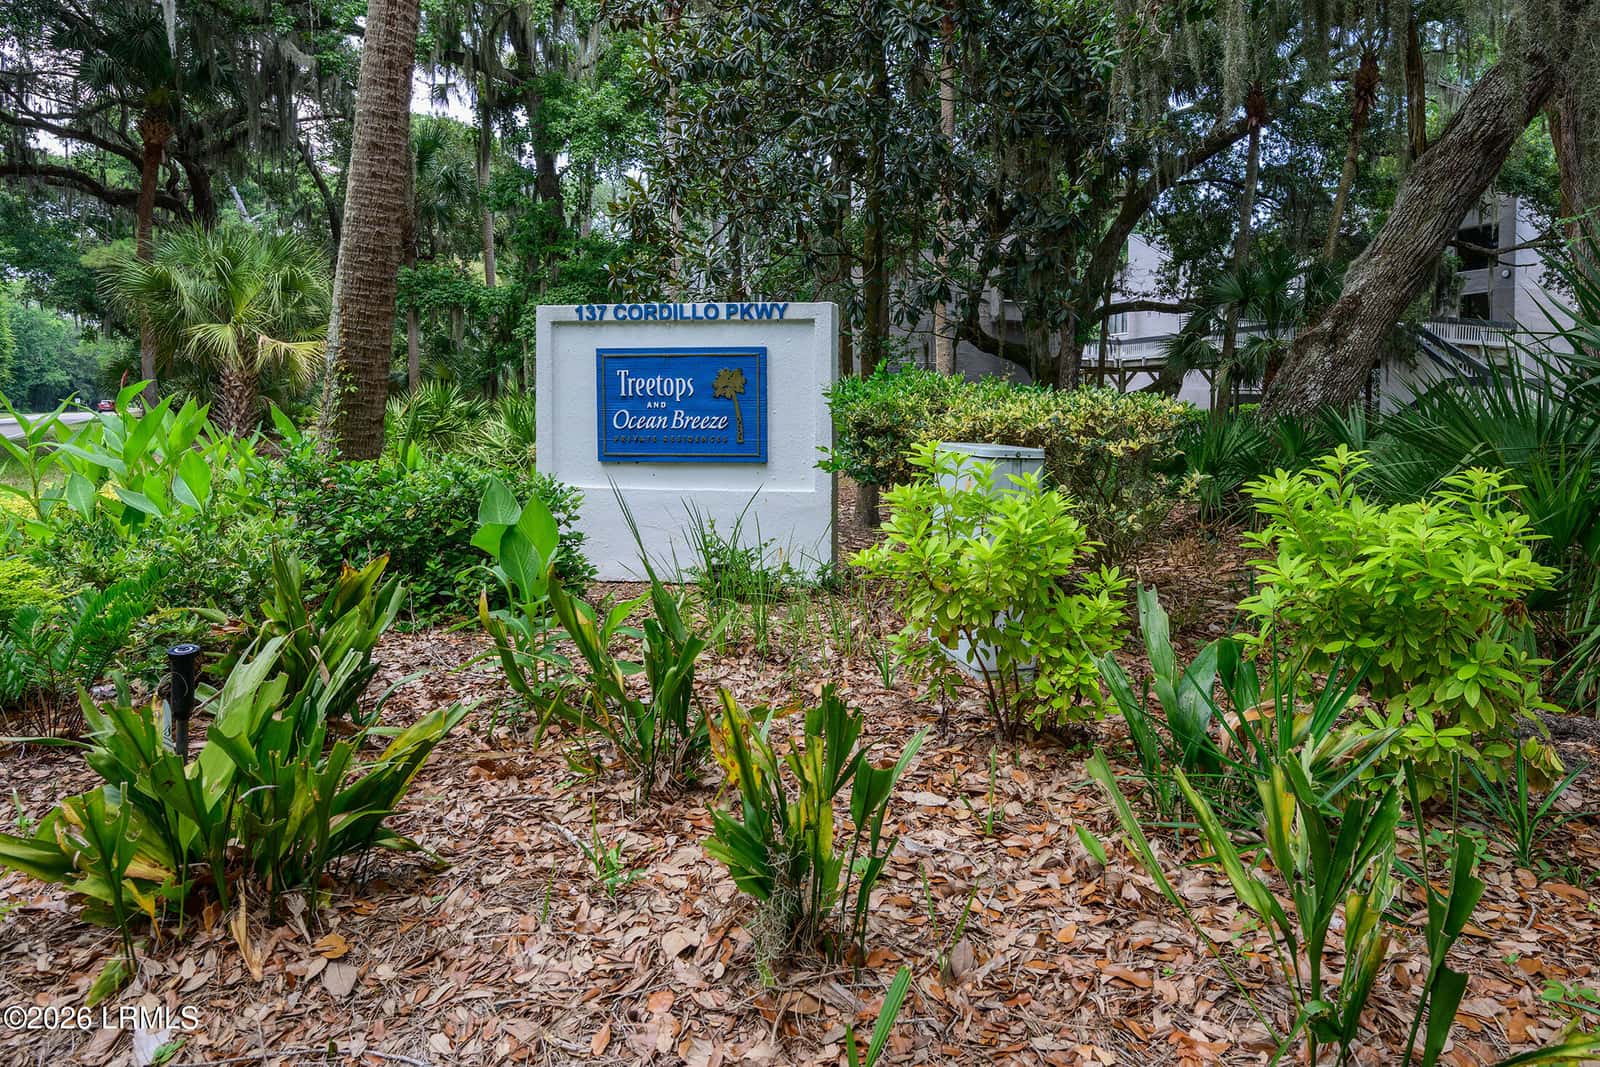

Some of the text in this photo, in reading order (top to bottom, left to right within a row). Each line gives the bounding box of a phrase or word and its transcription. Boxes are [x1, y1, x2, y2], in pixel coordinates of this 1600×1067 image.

[575, 303, 788, 320] 137 CORDILLO PKWY
[616, 369, 694, 402] Treetops
[646, 401, 667, 409] AND
[612, 409, 729, 429] Ocean Breeze
